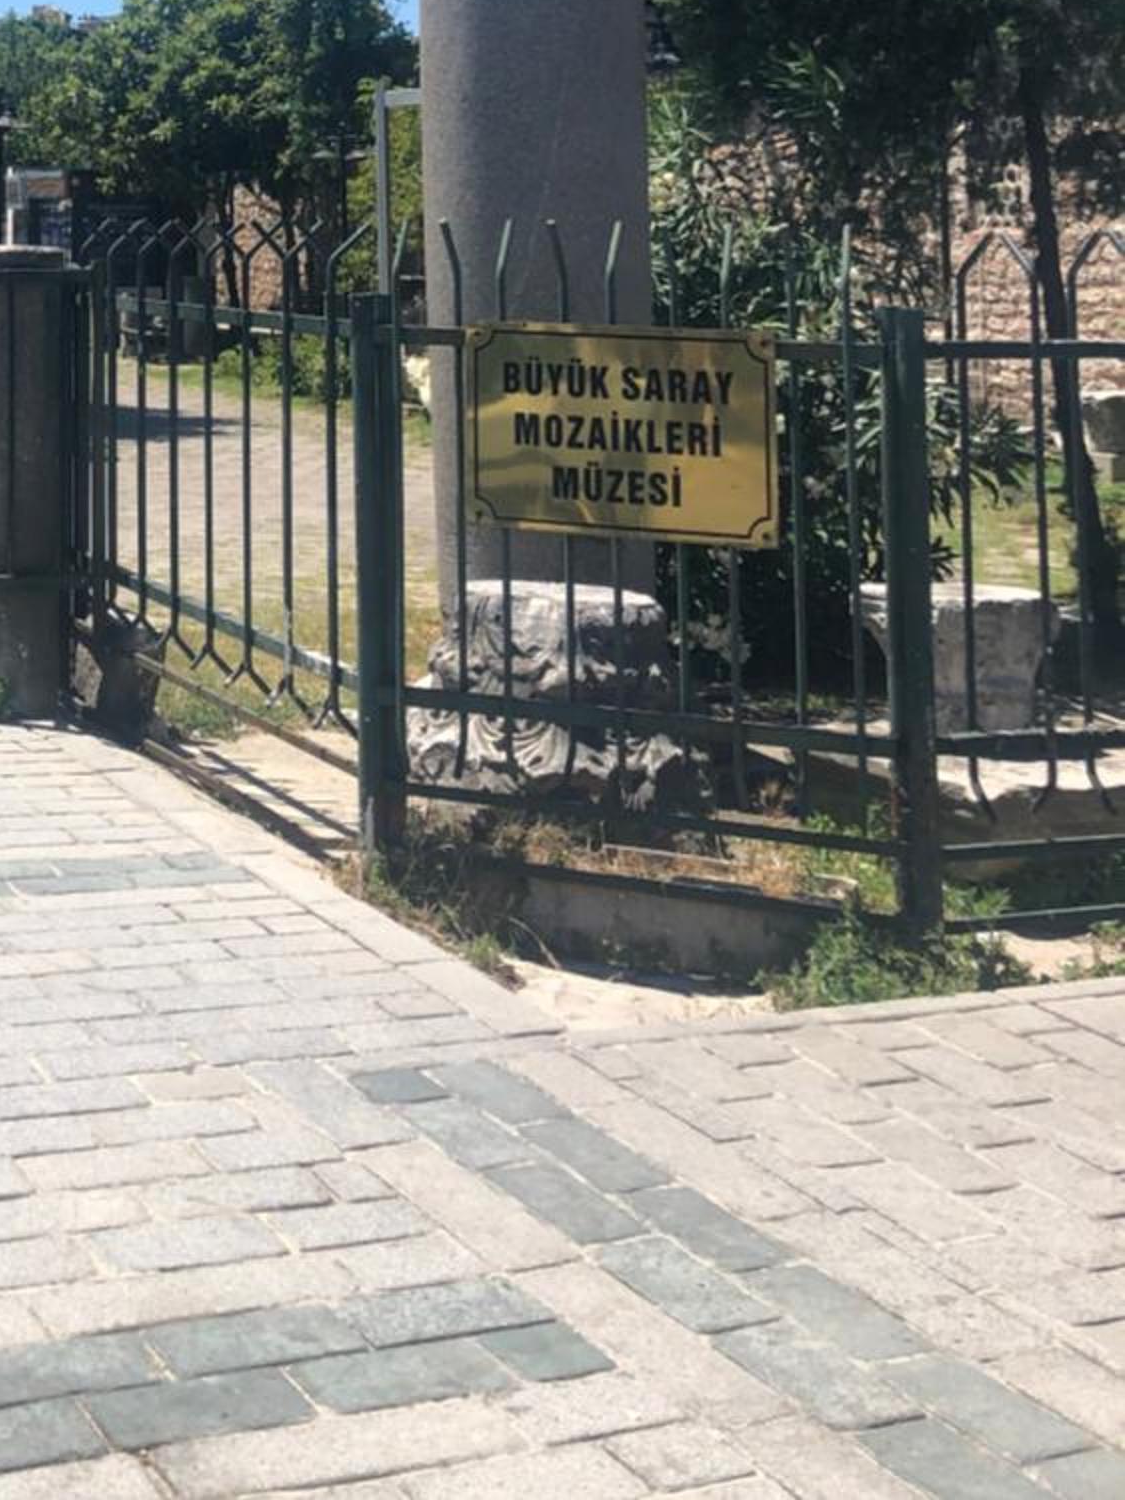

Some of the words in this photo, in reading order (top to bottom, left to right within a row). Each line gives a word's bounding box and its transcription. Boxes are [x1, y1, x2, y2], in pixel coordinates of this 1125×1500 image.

[502, 356, 610, 400] BÜYÜK
[621, 366, 734, 405] SARAY
[513, 410, 722, 457] MOZAİKLERİ
[552, 461, 683, 508] MÜZESİ
